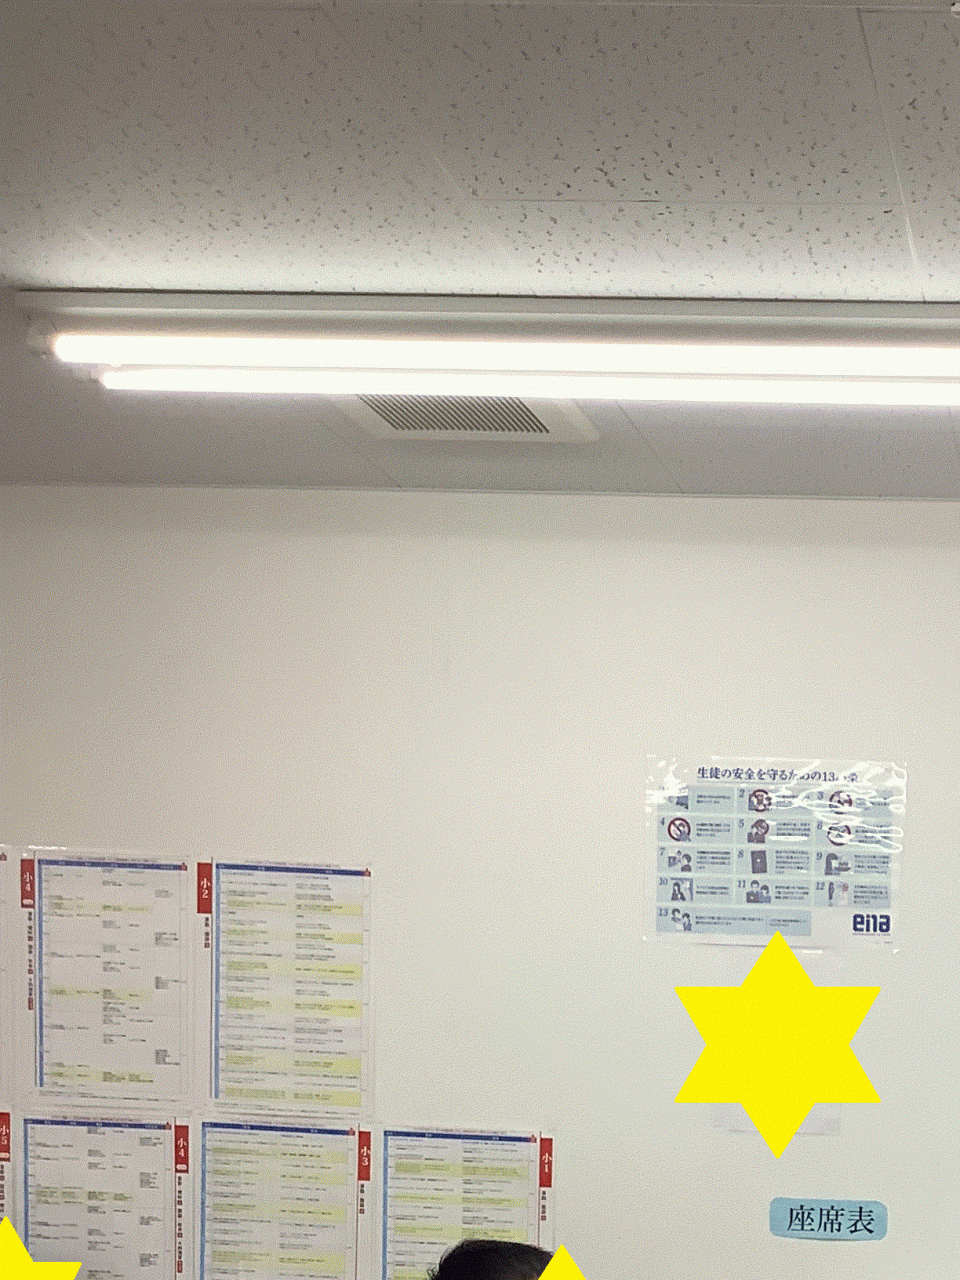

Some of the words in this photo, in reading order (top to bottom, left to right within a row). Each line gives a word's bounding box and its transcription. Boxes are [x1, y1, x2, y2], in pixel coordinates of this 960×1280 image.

[200, 877, 211, 899] 小2
[852, 913, 891, 933] ena
[786, 1203, 876, 1235] 座席表
